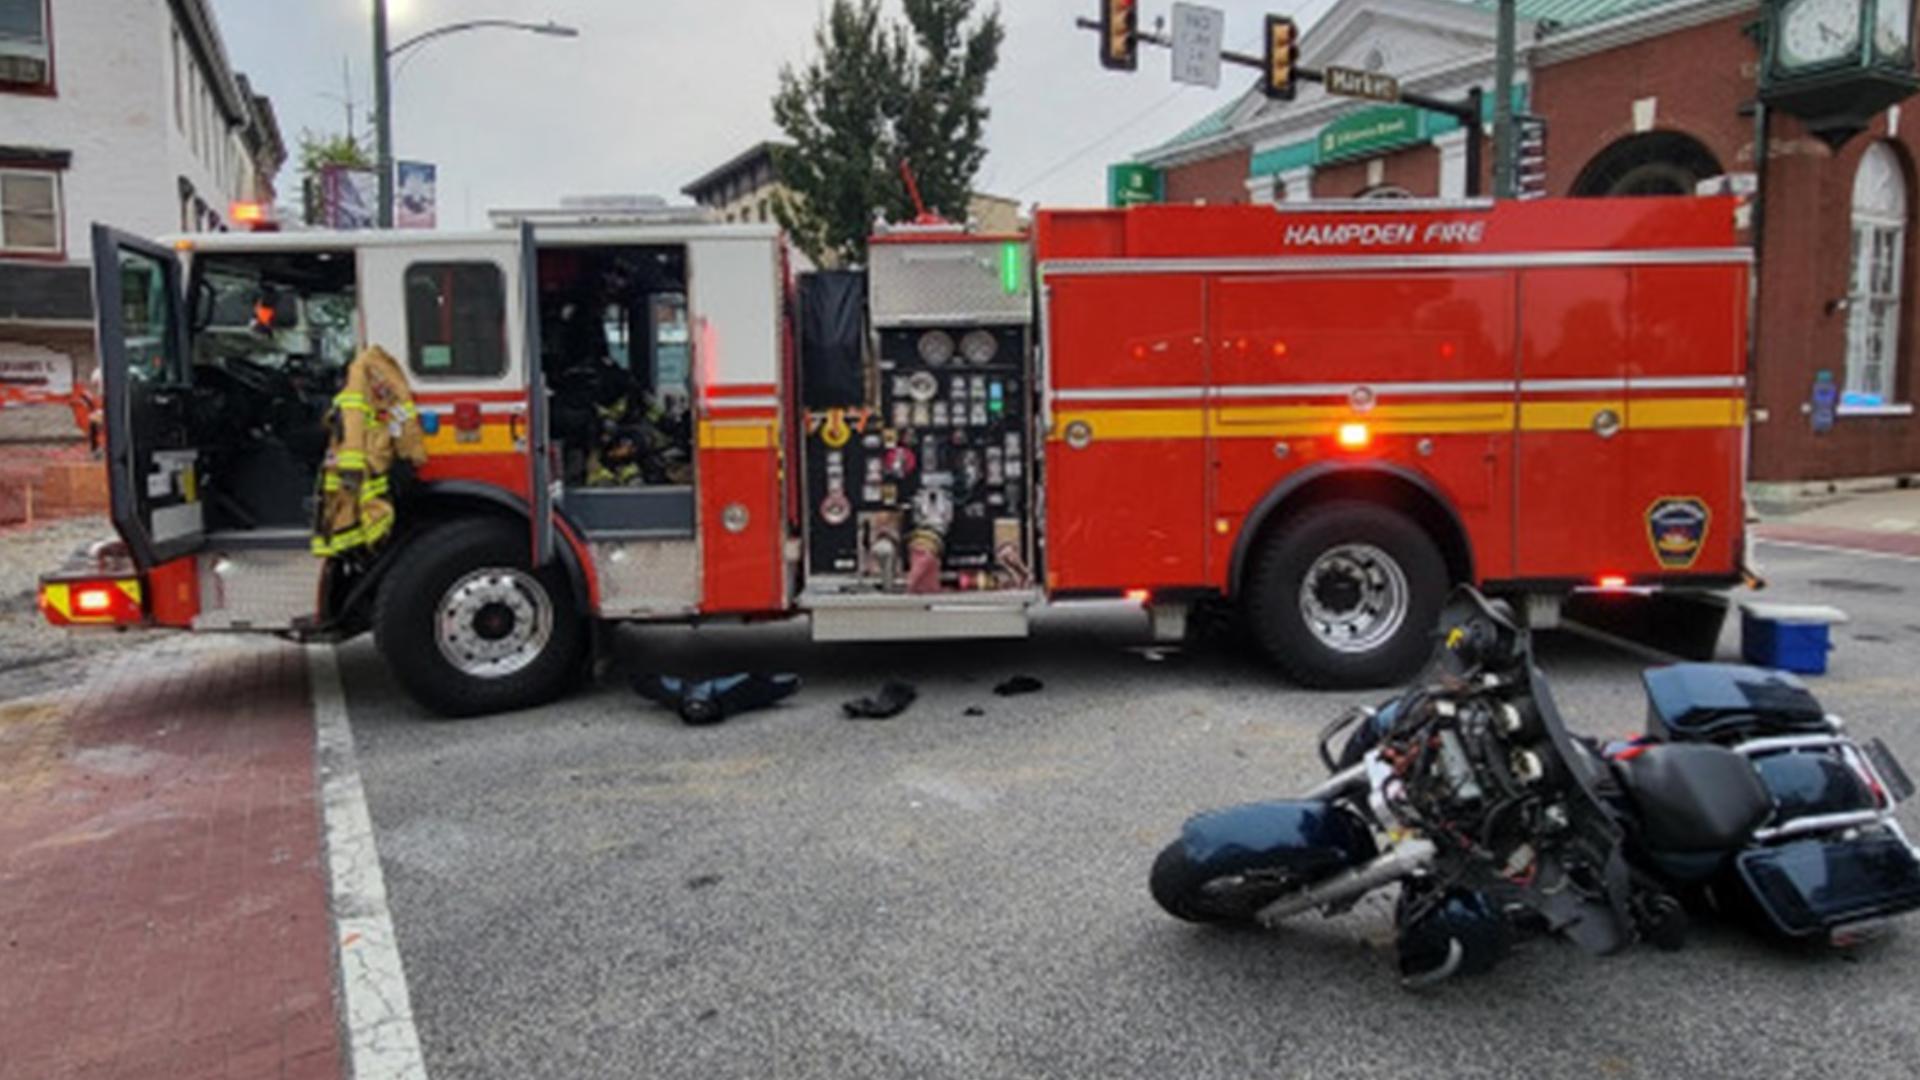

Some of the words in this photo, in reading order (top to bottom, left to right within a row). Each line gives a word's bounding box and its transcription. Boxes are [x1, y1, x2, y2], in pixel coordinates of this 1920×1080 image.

[1331, 70, 1394, 98] Market
[1283, 223, 1417, 246] HAMPDEN
[1423, 220, 1487, 245] FIRE
